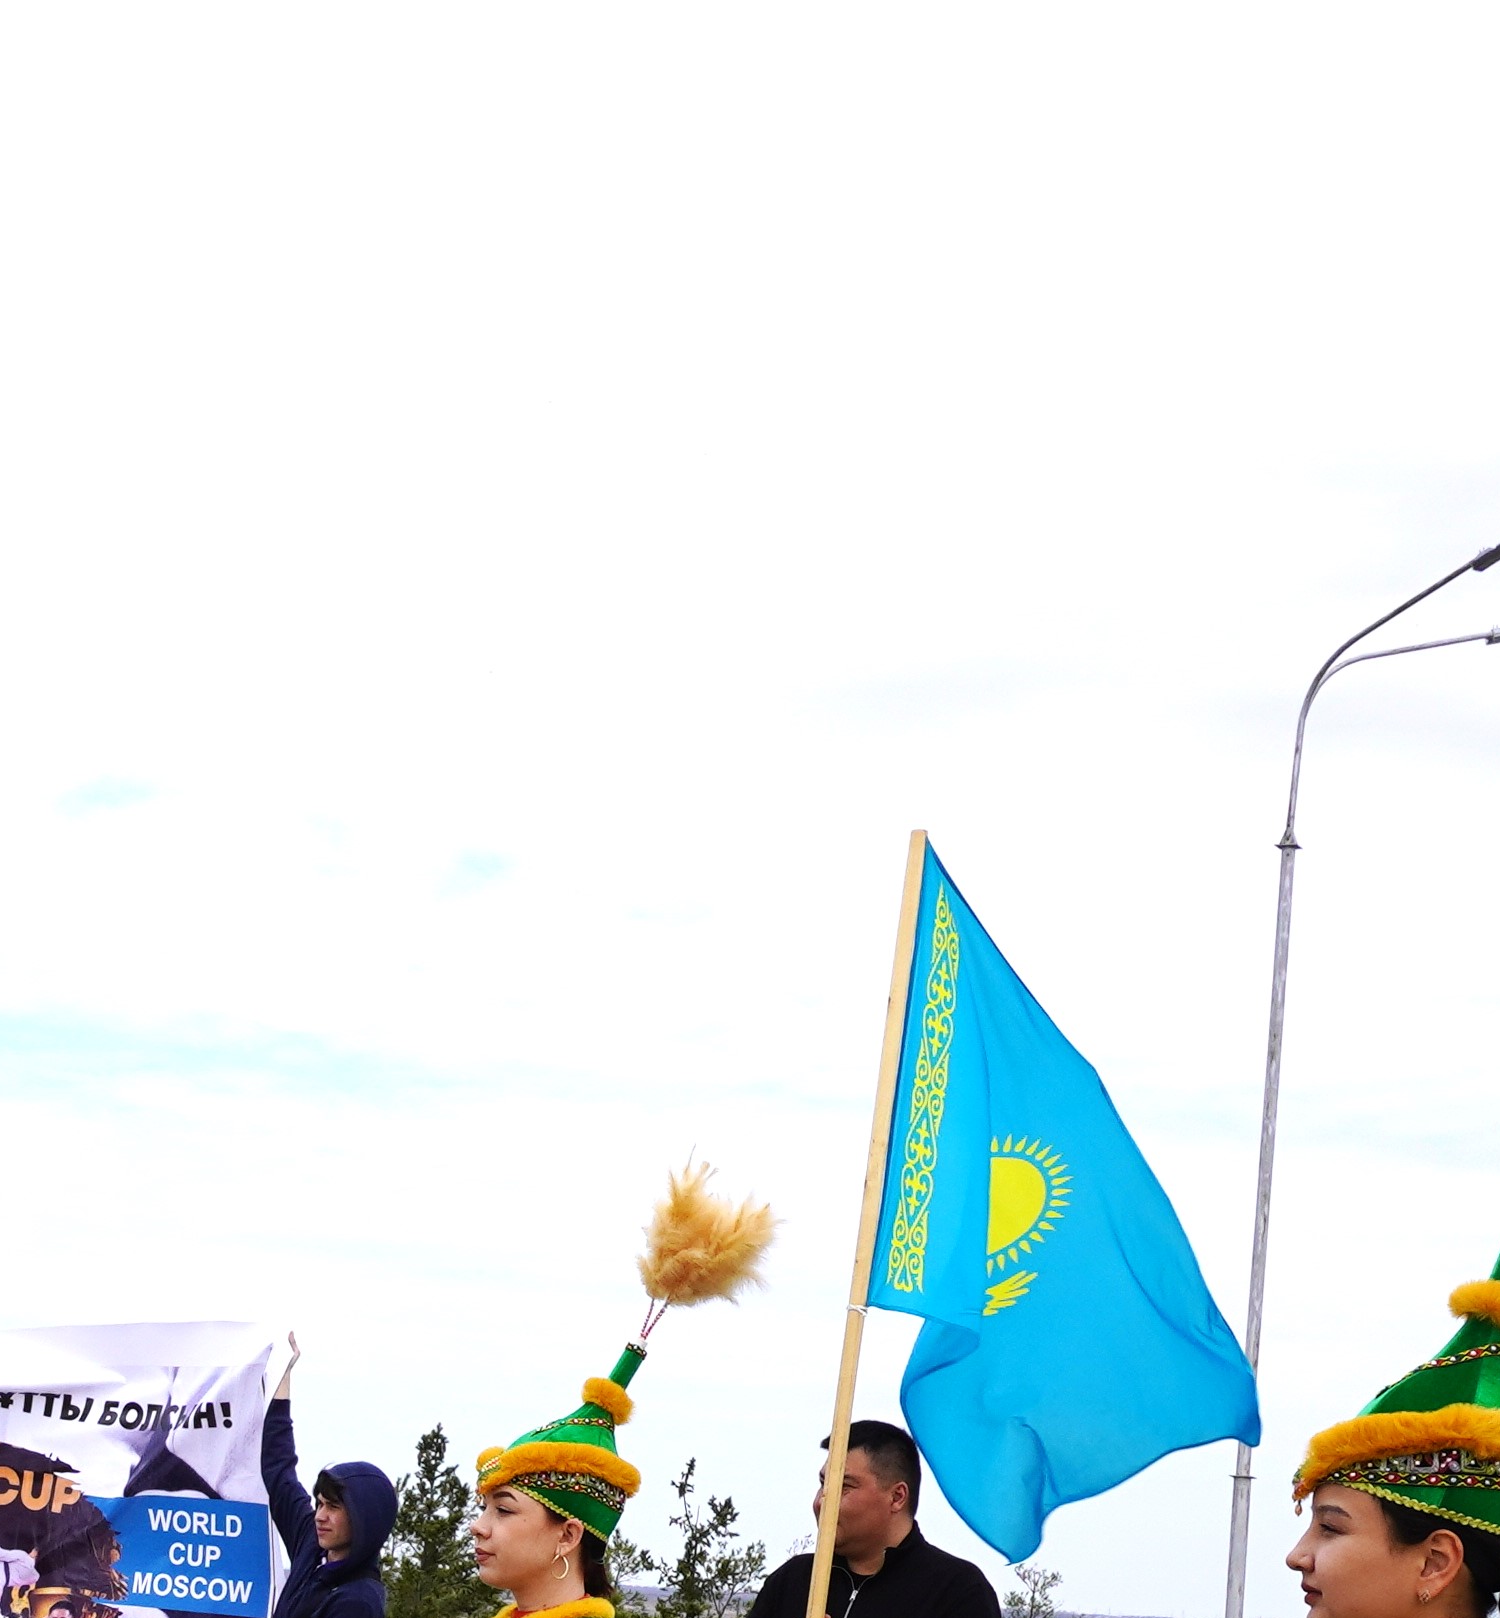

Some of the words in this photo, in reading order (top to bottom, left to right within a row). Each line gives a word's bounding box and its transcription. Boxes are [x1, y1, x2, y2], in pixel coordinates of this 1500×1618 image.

[147, 1508, 243, 1538] WORLD
[168, 1542, 221, 1568] CUP
[132, 1571, 253, 1604] MOSCOW
